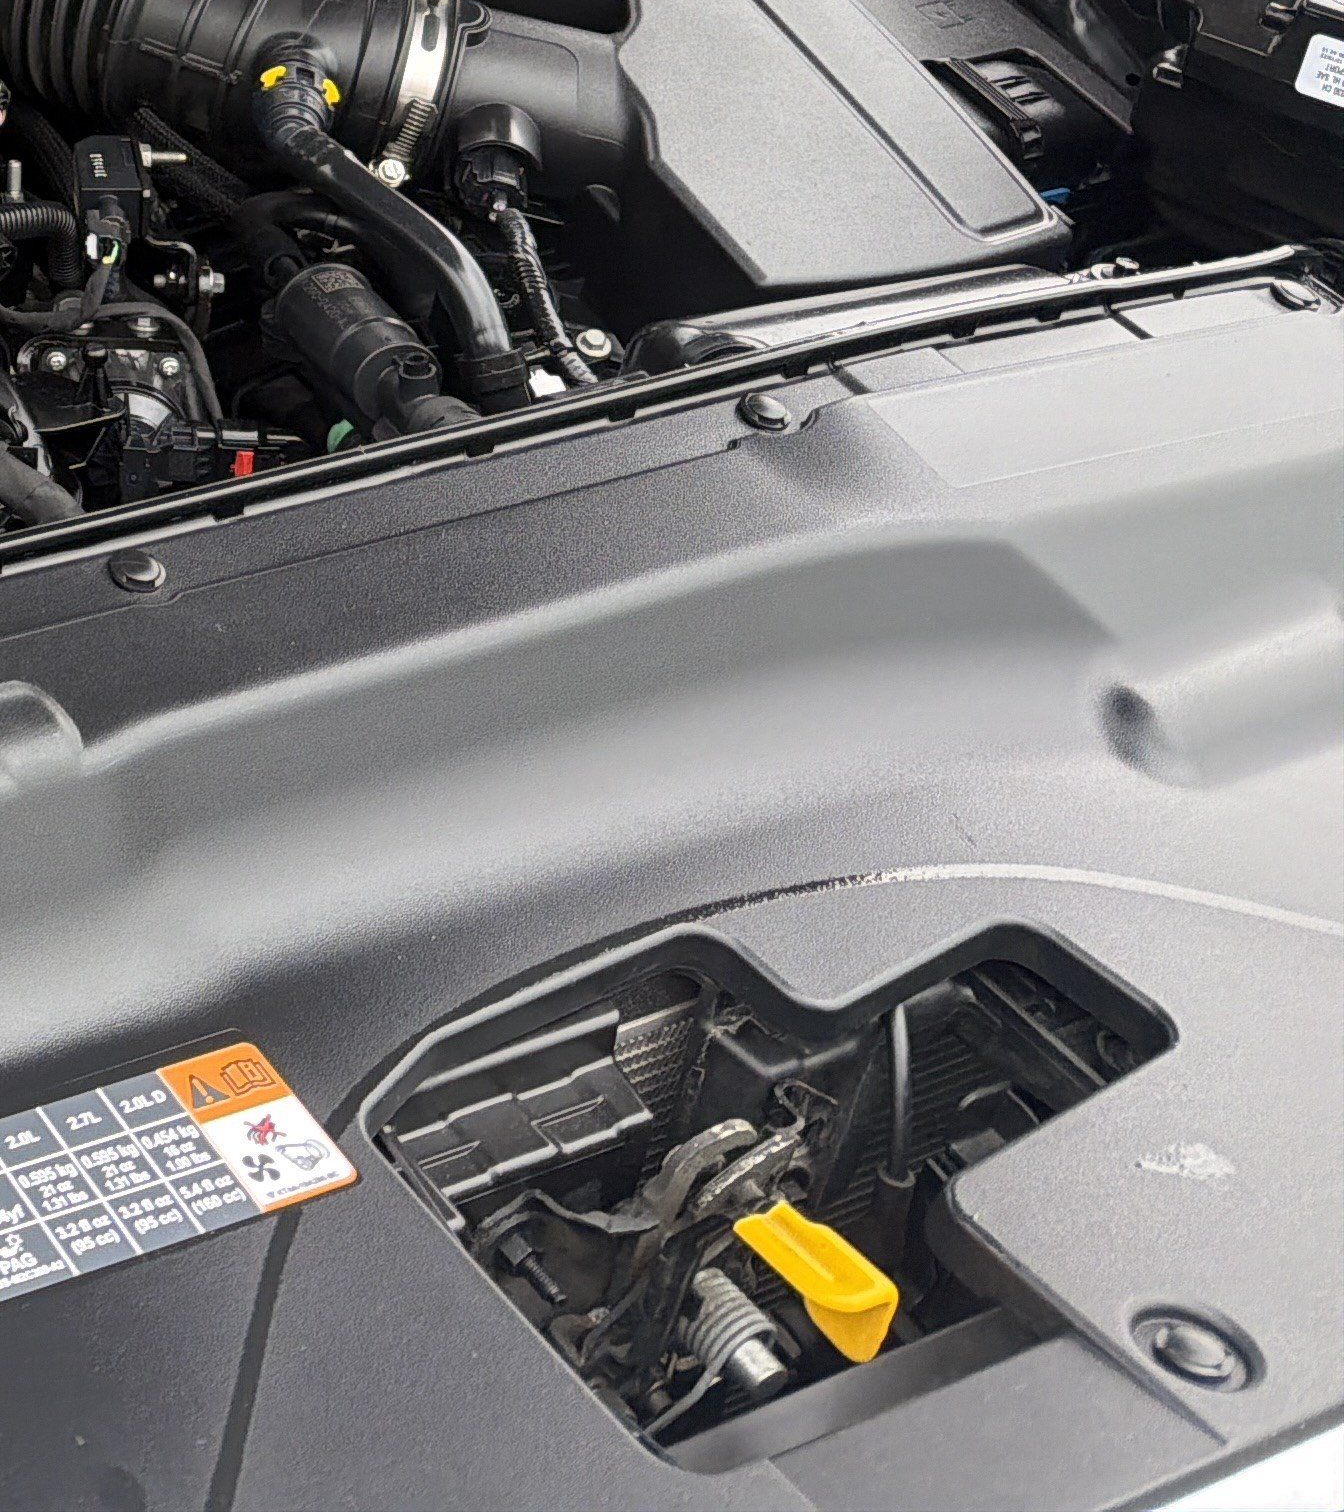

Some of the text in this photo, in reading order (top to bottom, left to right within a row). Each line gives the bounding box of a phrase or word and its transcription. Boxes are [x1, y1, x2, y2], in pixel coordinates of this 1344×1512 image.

[119, 1089, 167, 1114] 2.0L D
[66, 1111, 103, 1130] 2.7L
[4, 1130, 41, 1150] 2.0L
[141, 1123, 201, 1150] 0.454 kg
[117, 1143, 141, 1159] kg
[179, 1141, 196, 1153] oz
[190, 1151, 212, 1164] lbs
[54, 1162, 79, 1179] kg
[101, 1160, 137, 1178] 21 oz
[129, 1169, 151, 1184] lbs
[38, 1180, 75, 1198] 21 oz
[179, 1183, 203, 1199] 5.4
[215, 1174, 234, 1188] oz
[66, 1190, 89, 1204] lbs
[191, 1187, 247, 1216] (160 cc)
[118, 1204, 143, 1220] 3.2
[155, 1194, 175, 1208] oz
[55, 1223, 81, 1240] 3.2
[93, 1214, 112, 1228] oz
[134, 1208, 184, 1235] (95 cc)
[70, 1228, 121, 1256] (95 cc)
